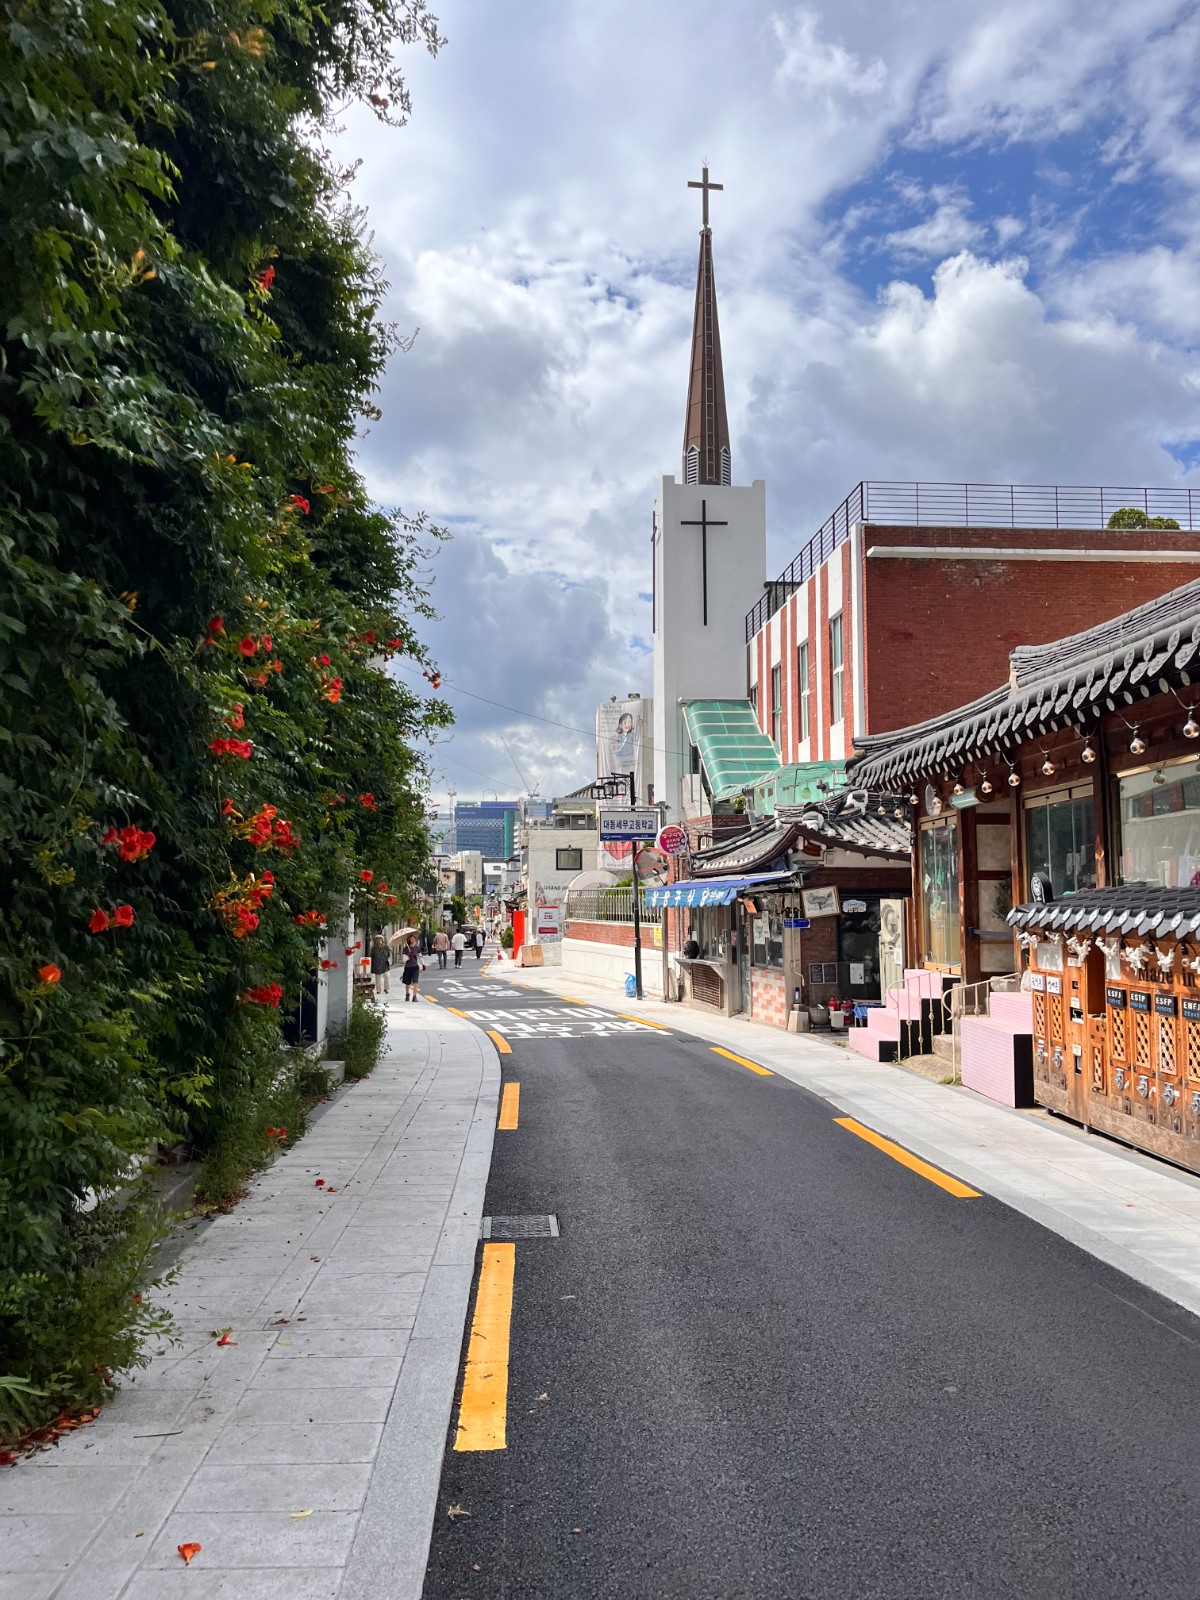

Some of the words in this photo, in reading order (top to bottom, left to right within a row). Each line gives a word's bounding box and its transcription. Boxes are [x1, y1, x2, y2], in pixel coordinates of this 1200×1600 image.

[603, 819, 654, 830] 대동세무고등학교
[1182, 967, 1197, 987] in
[1107, 989, 1122, 999] ESFJ
[1130, 993, 1146, 1002] ESTP
[1155, 997, 1172, 1006] ESFP
[465, 1007, 619, 1021] 어린이
[491, 1021, 674, 1039] 보호구역
